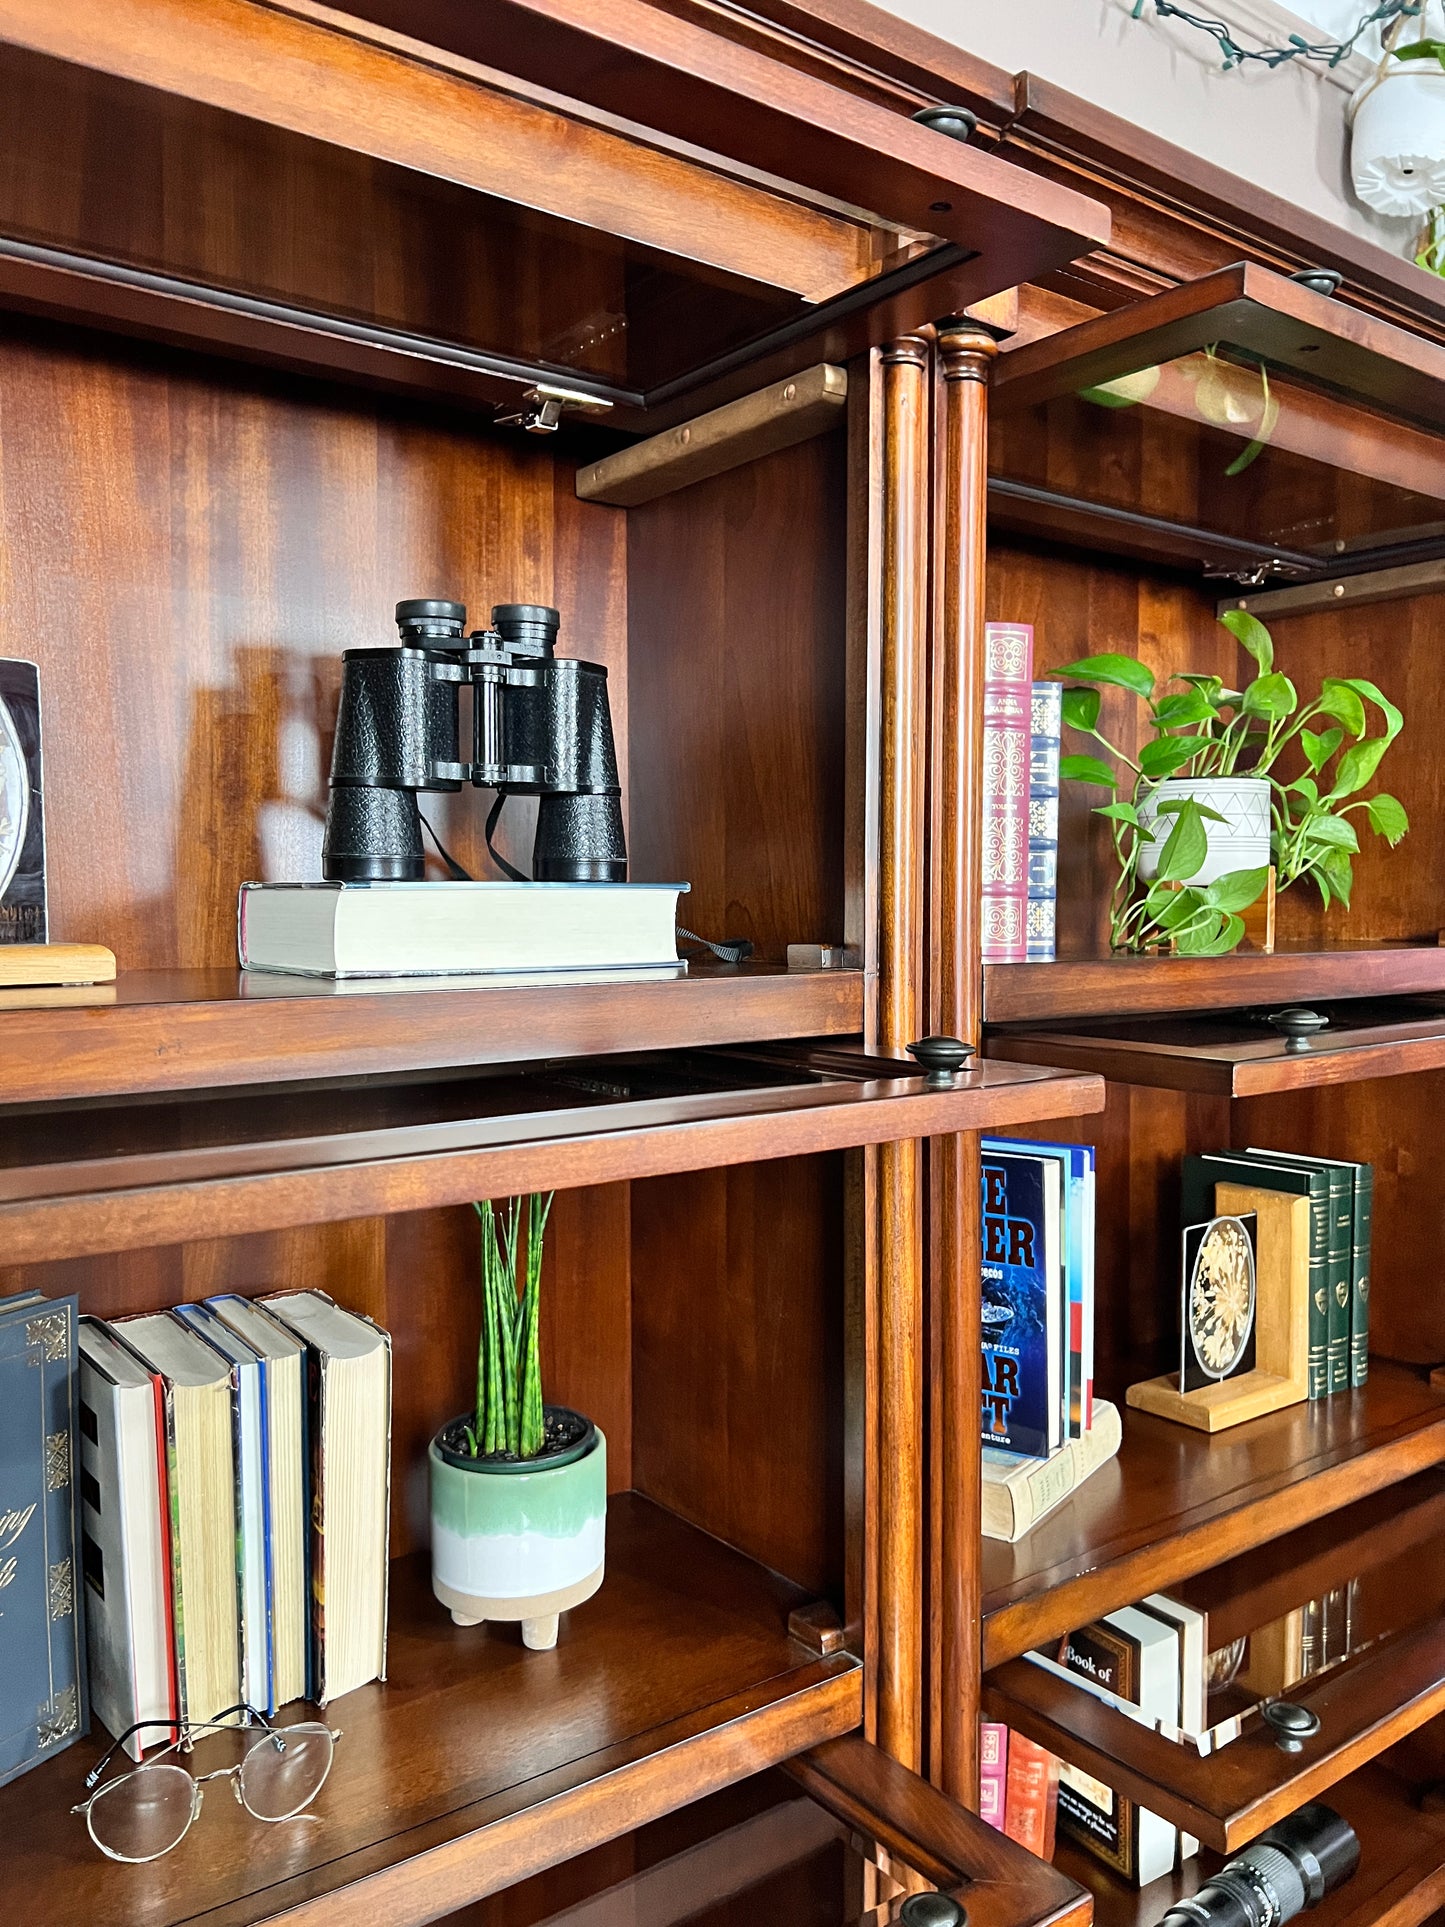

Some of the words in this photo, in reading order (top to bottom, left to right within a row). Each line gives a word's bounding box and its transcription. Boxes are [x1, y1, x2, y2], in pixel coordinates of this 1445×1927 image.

[993, 1344, 1020, 1356] FILES
[1065, 1645, 1096, 1675] Book
[1098, 1668, 1112, 1683] of
